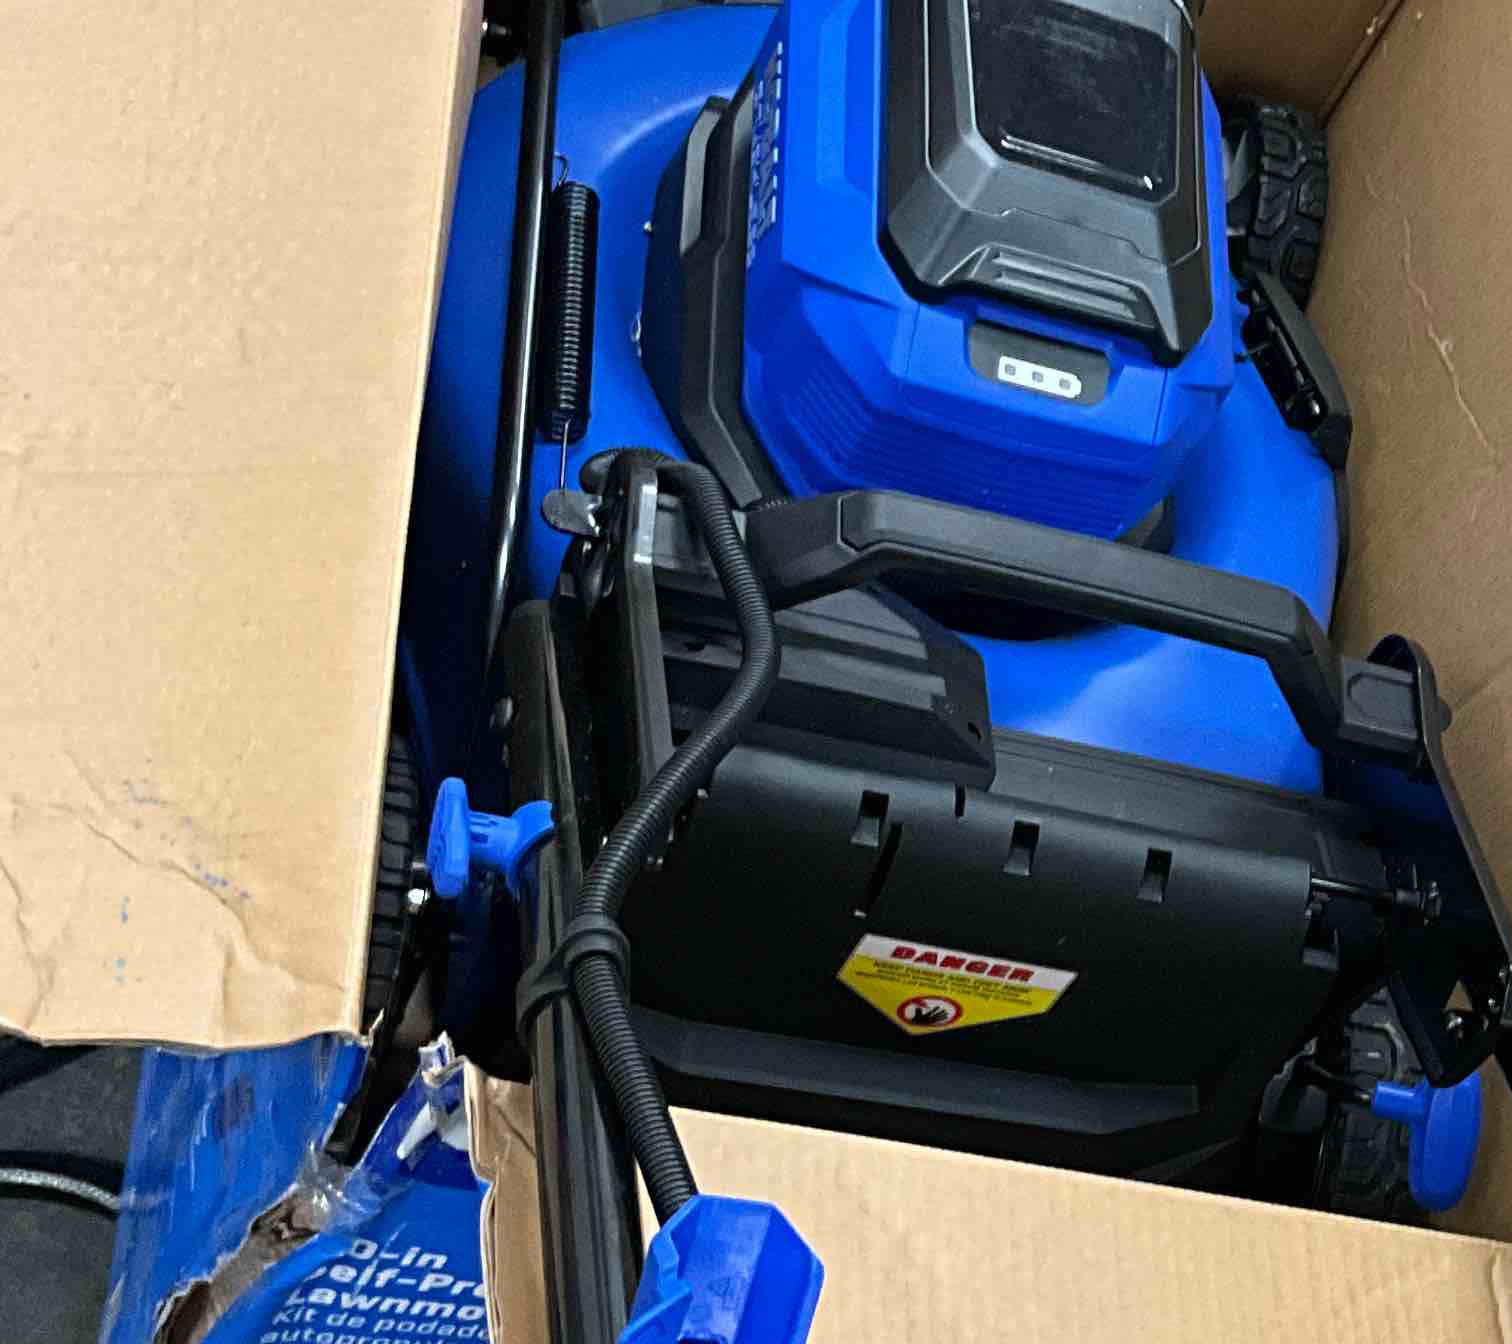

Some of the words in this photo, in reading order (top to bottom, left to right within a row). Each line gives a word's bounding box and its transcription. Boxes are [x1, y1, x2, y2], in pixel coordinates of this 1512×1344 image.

[890, 945, 1035, 983] DANGER
[340, 1238, 448, 1270] 0-In
[273, 1306, 318, 1325] Kit
[326, 1311, 367, 1328] de
